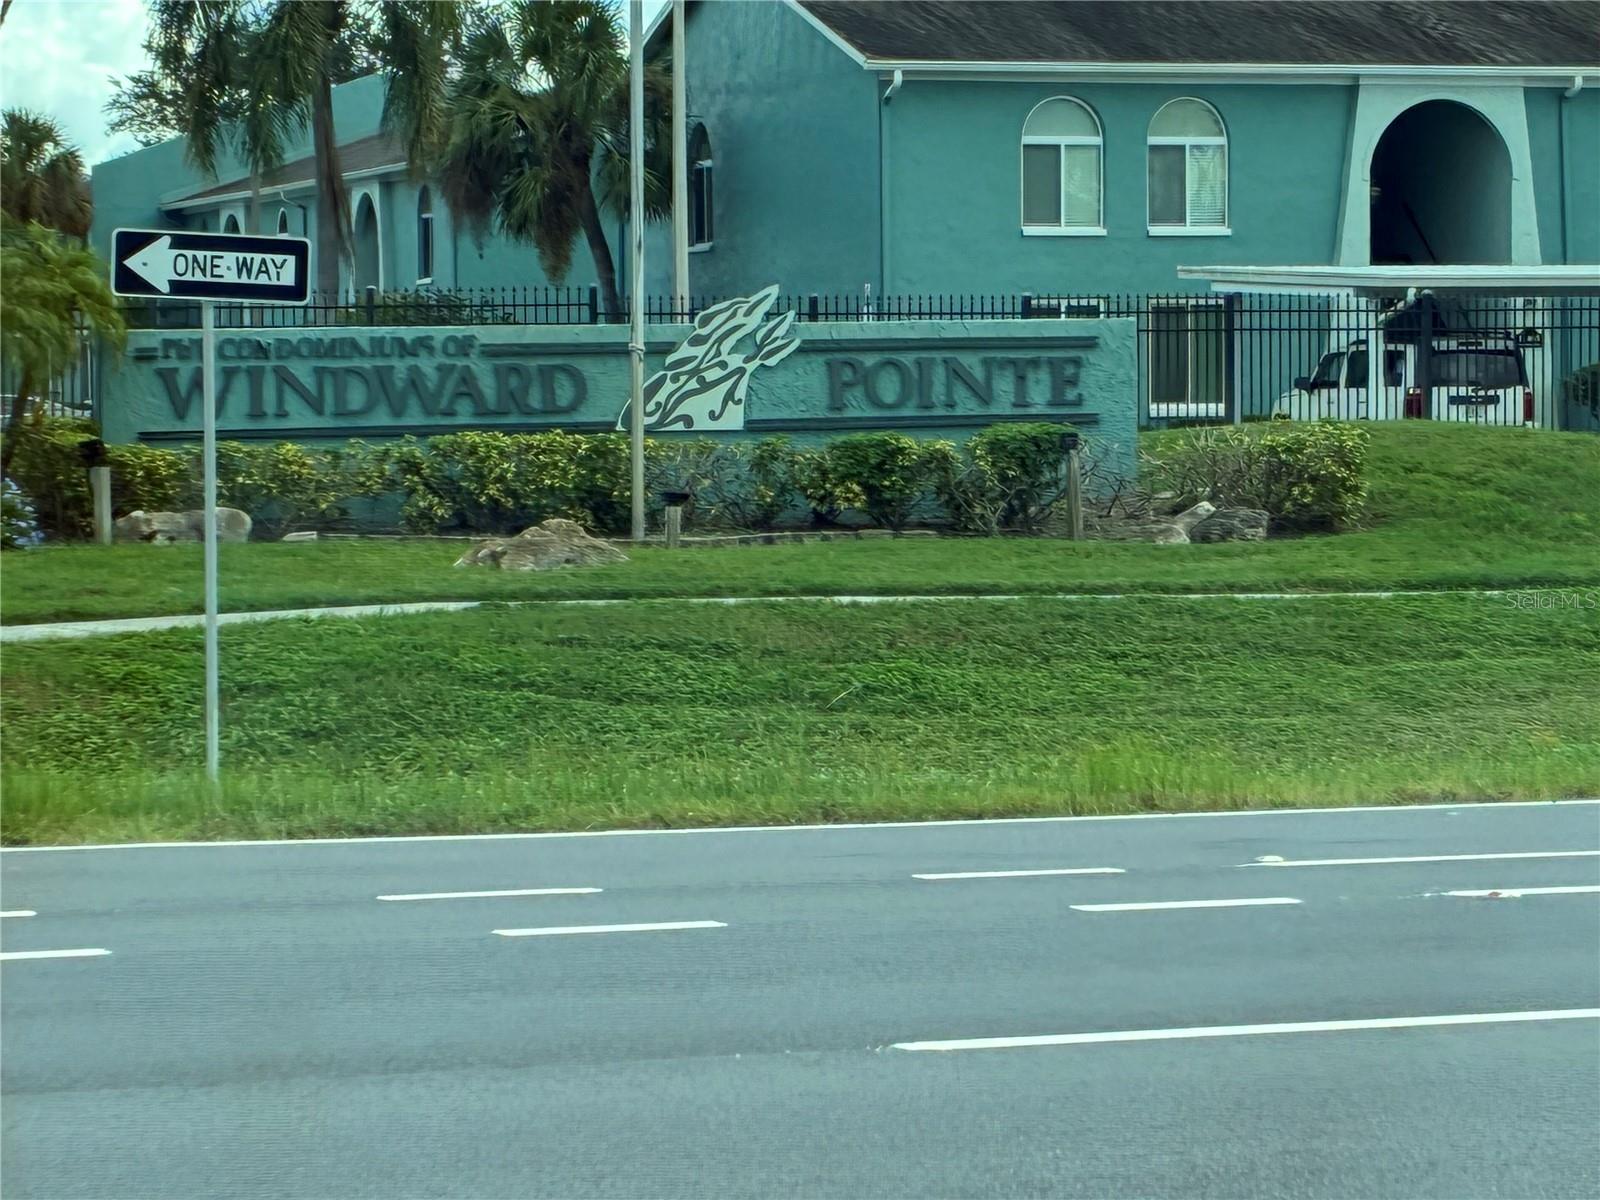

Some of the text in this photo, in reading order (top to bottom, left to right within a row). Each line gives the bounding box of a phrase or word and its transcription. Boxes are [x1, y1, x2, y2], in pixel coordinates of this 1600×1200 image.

[173, 252, 288, 282] ONE WAY
[154, 355, 1083, 420] WINDWARD POINTE
